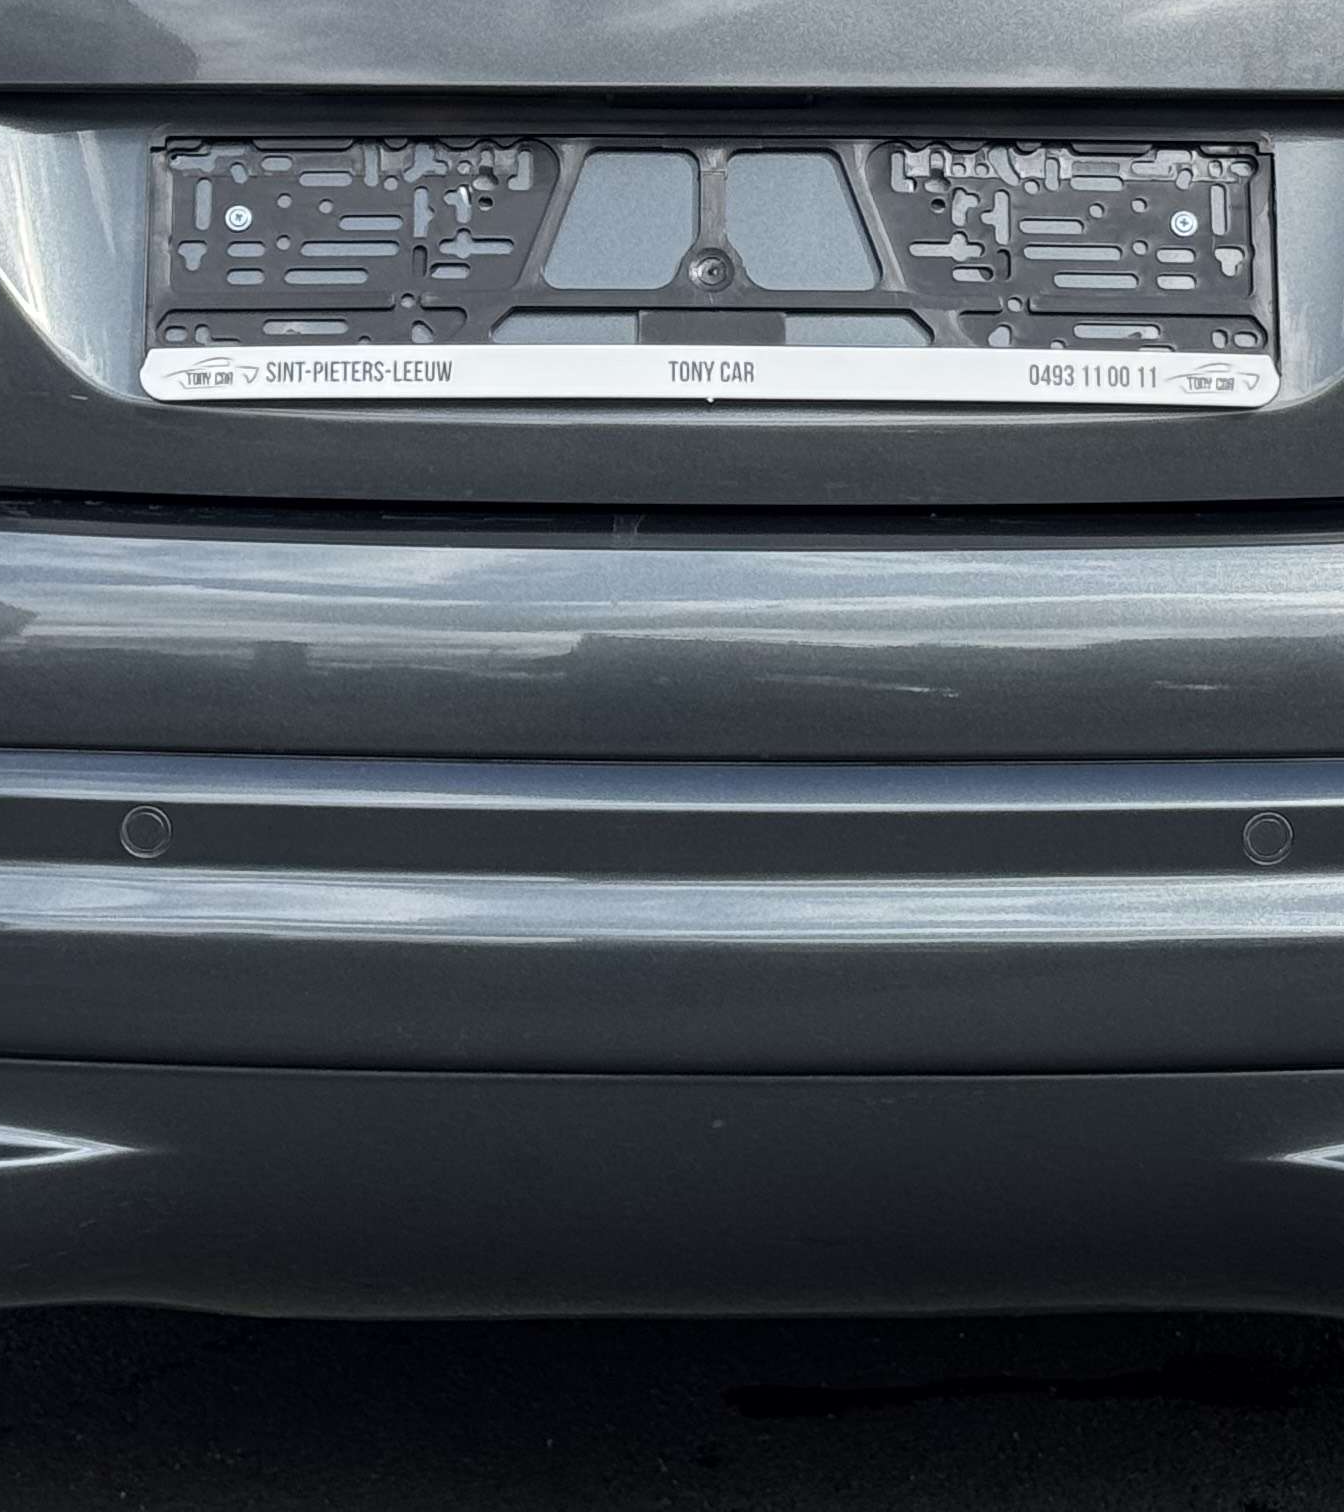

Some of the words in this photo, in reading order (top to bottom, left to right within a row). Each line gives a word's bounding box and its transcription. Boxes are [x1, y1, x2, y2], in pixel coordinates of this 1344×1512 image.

[265, 360, 453, 383] SINT-PIETERS-LEEUW
[668, 361, 715, 382] TONY
[720, 361, 754, 383] CAR
[1029, 364, 1075, 386] 0493
